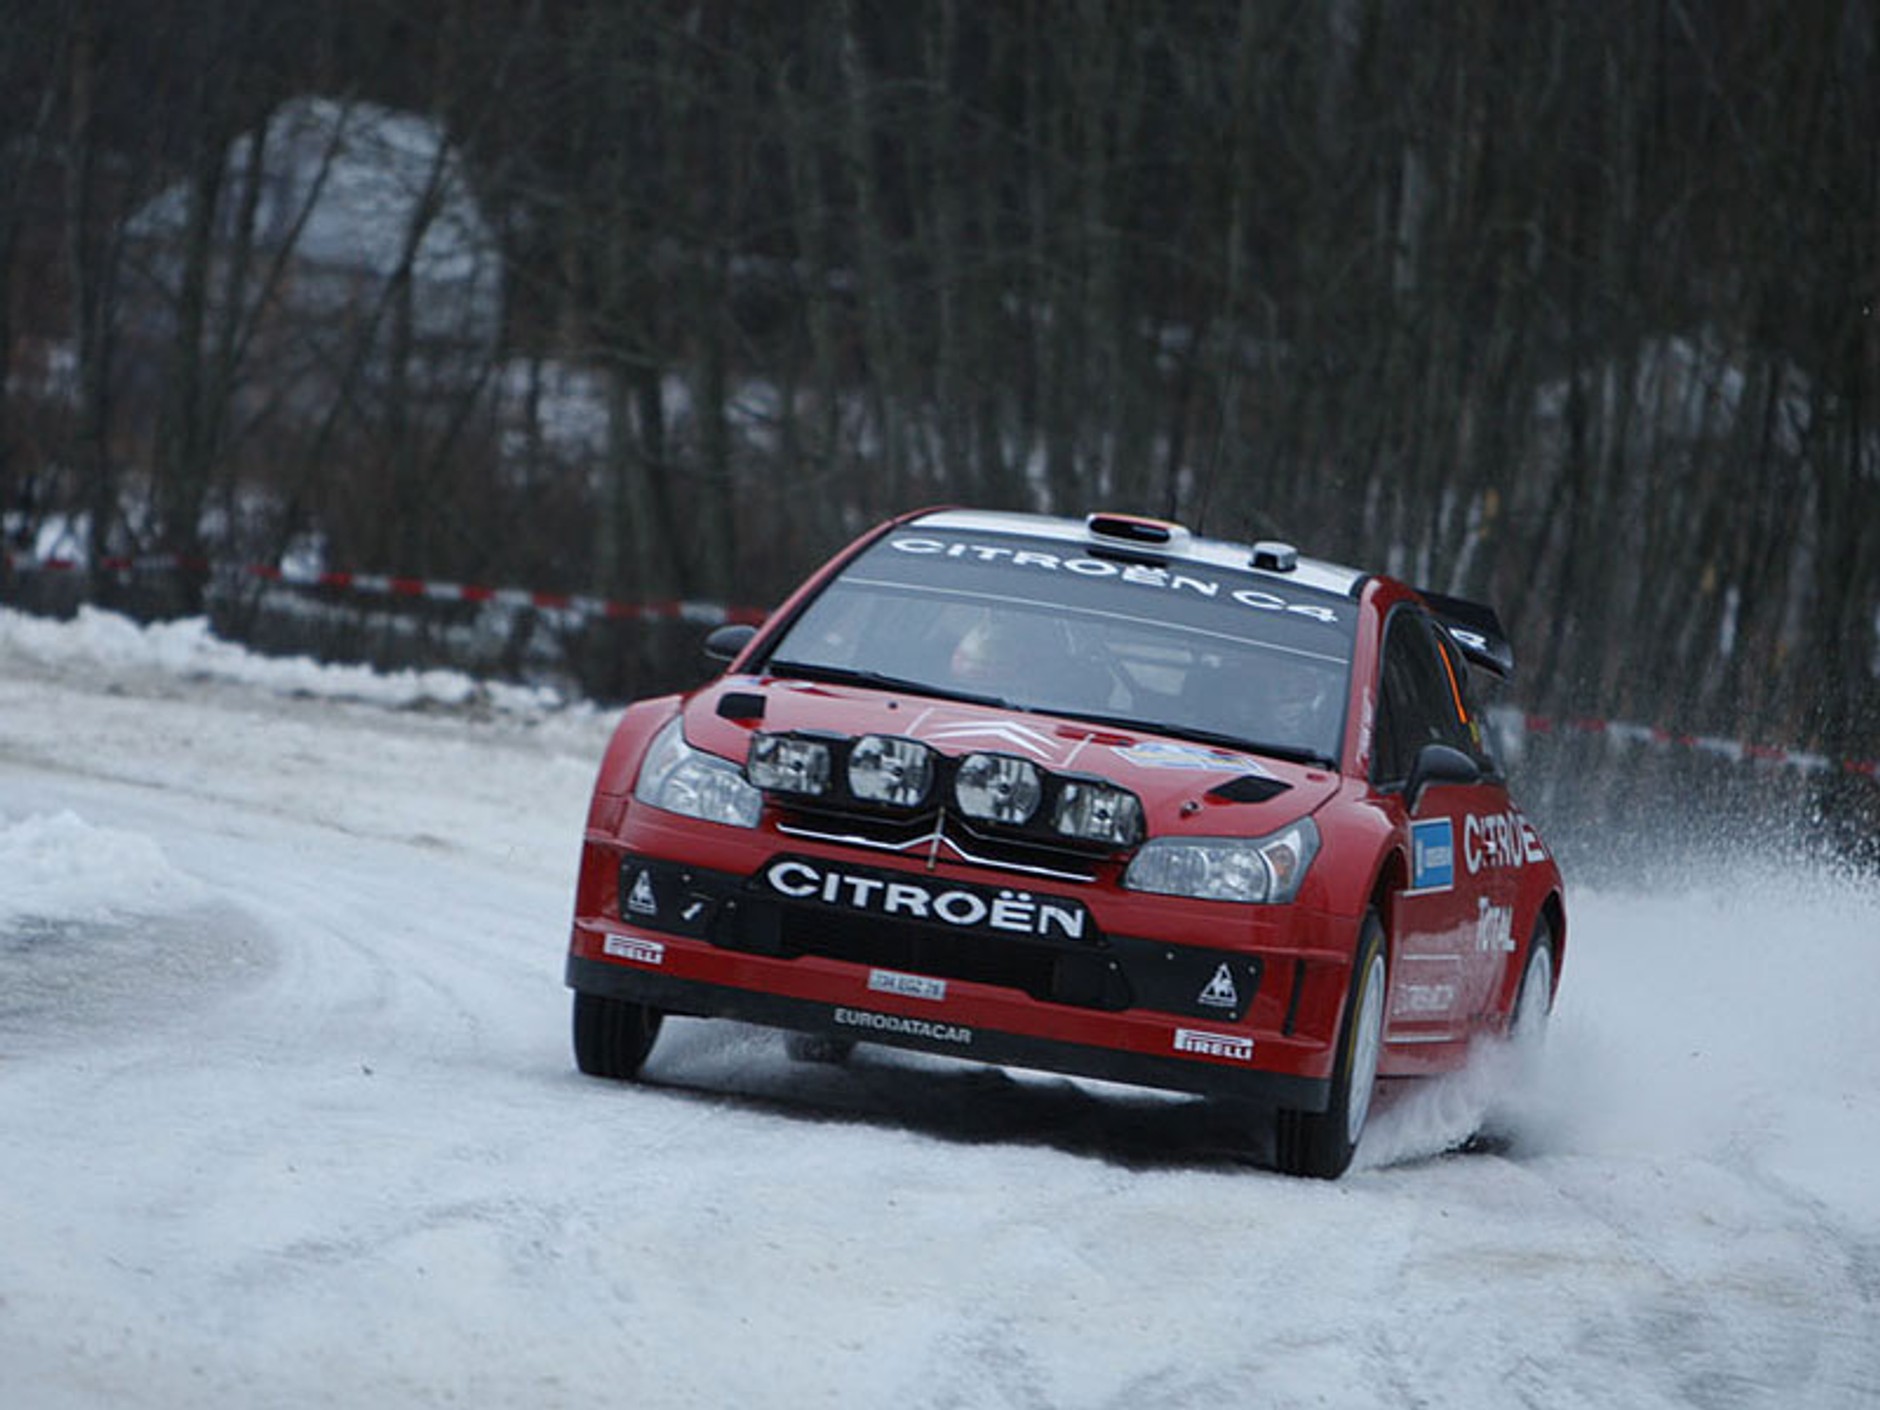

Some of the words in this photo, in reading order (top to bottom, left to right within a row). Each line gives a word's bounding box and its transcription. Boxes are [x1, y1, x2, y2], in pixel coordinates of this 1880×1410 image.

[890, 537, 1219, 597] CITROËN
[1230, 589, 1338, 623] C4
[767, 861, 1085, 938] CITROËN
[834, 1008, 973, 1044] EURODATACAR
[1173, 1027, 1254, 1061] PIRELLI
